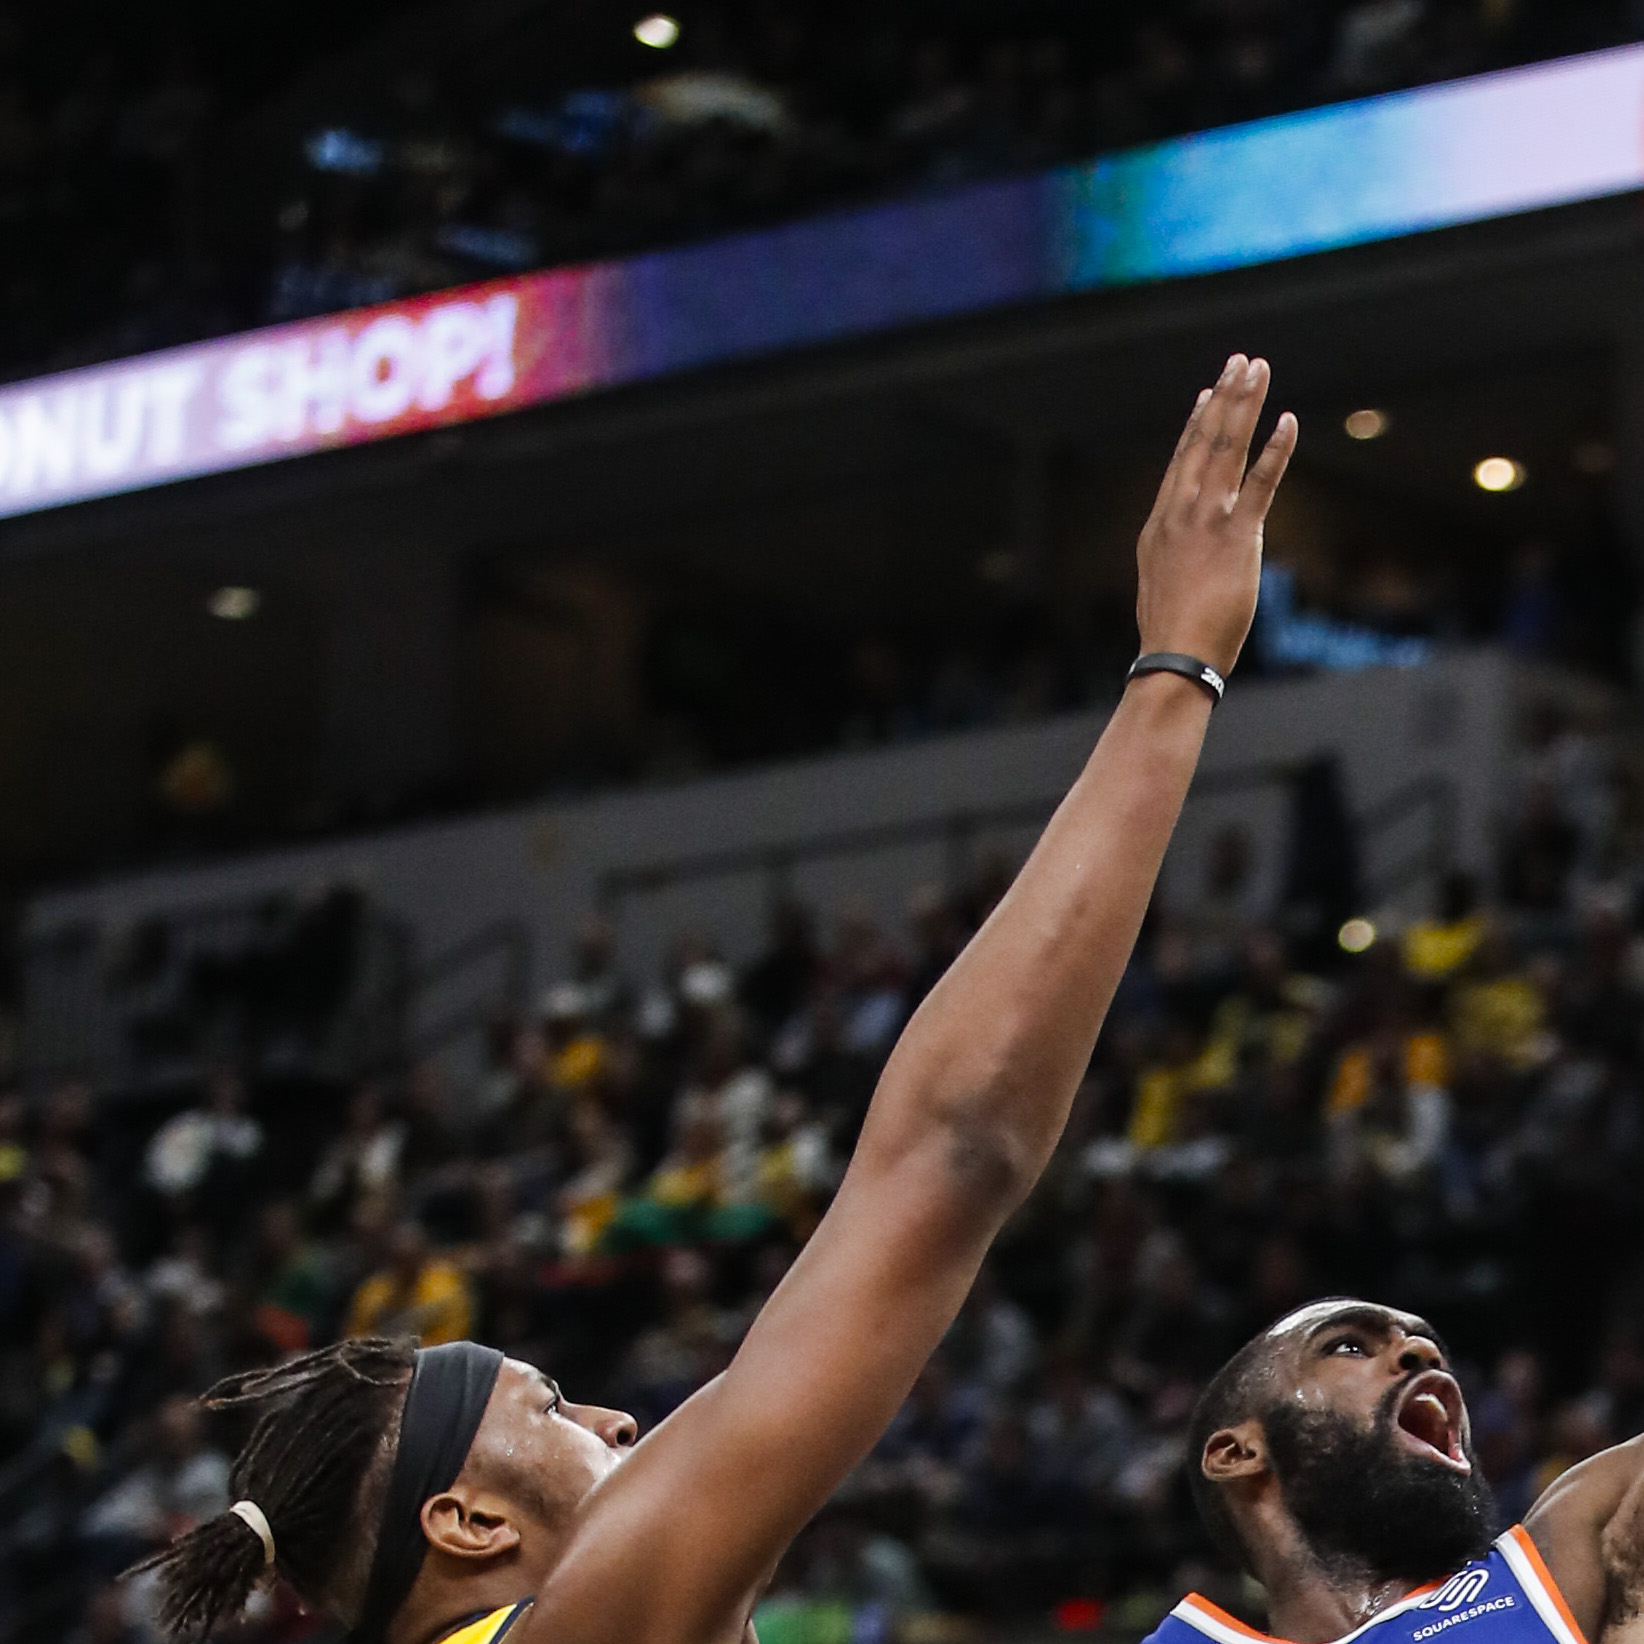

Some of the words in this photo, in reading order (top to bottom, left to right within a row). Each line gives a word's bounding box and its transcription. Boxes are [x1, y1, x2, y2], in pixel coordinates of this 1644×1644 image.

[0, 354, 203, 498] NUT
[217, 293, 518, 450] SHOP!
[1413, 1596, 1515, 1641] SQUARESPACE
